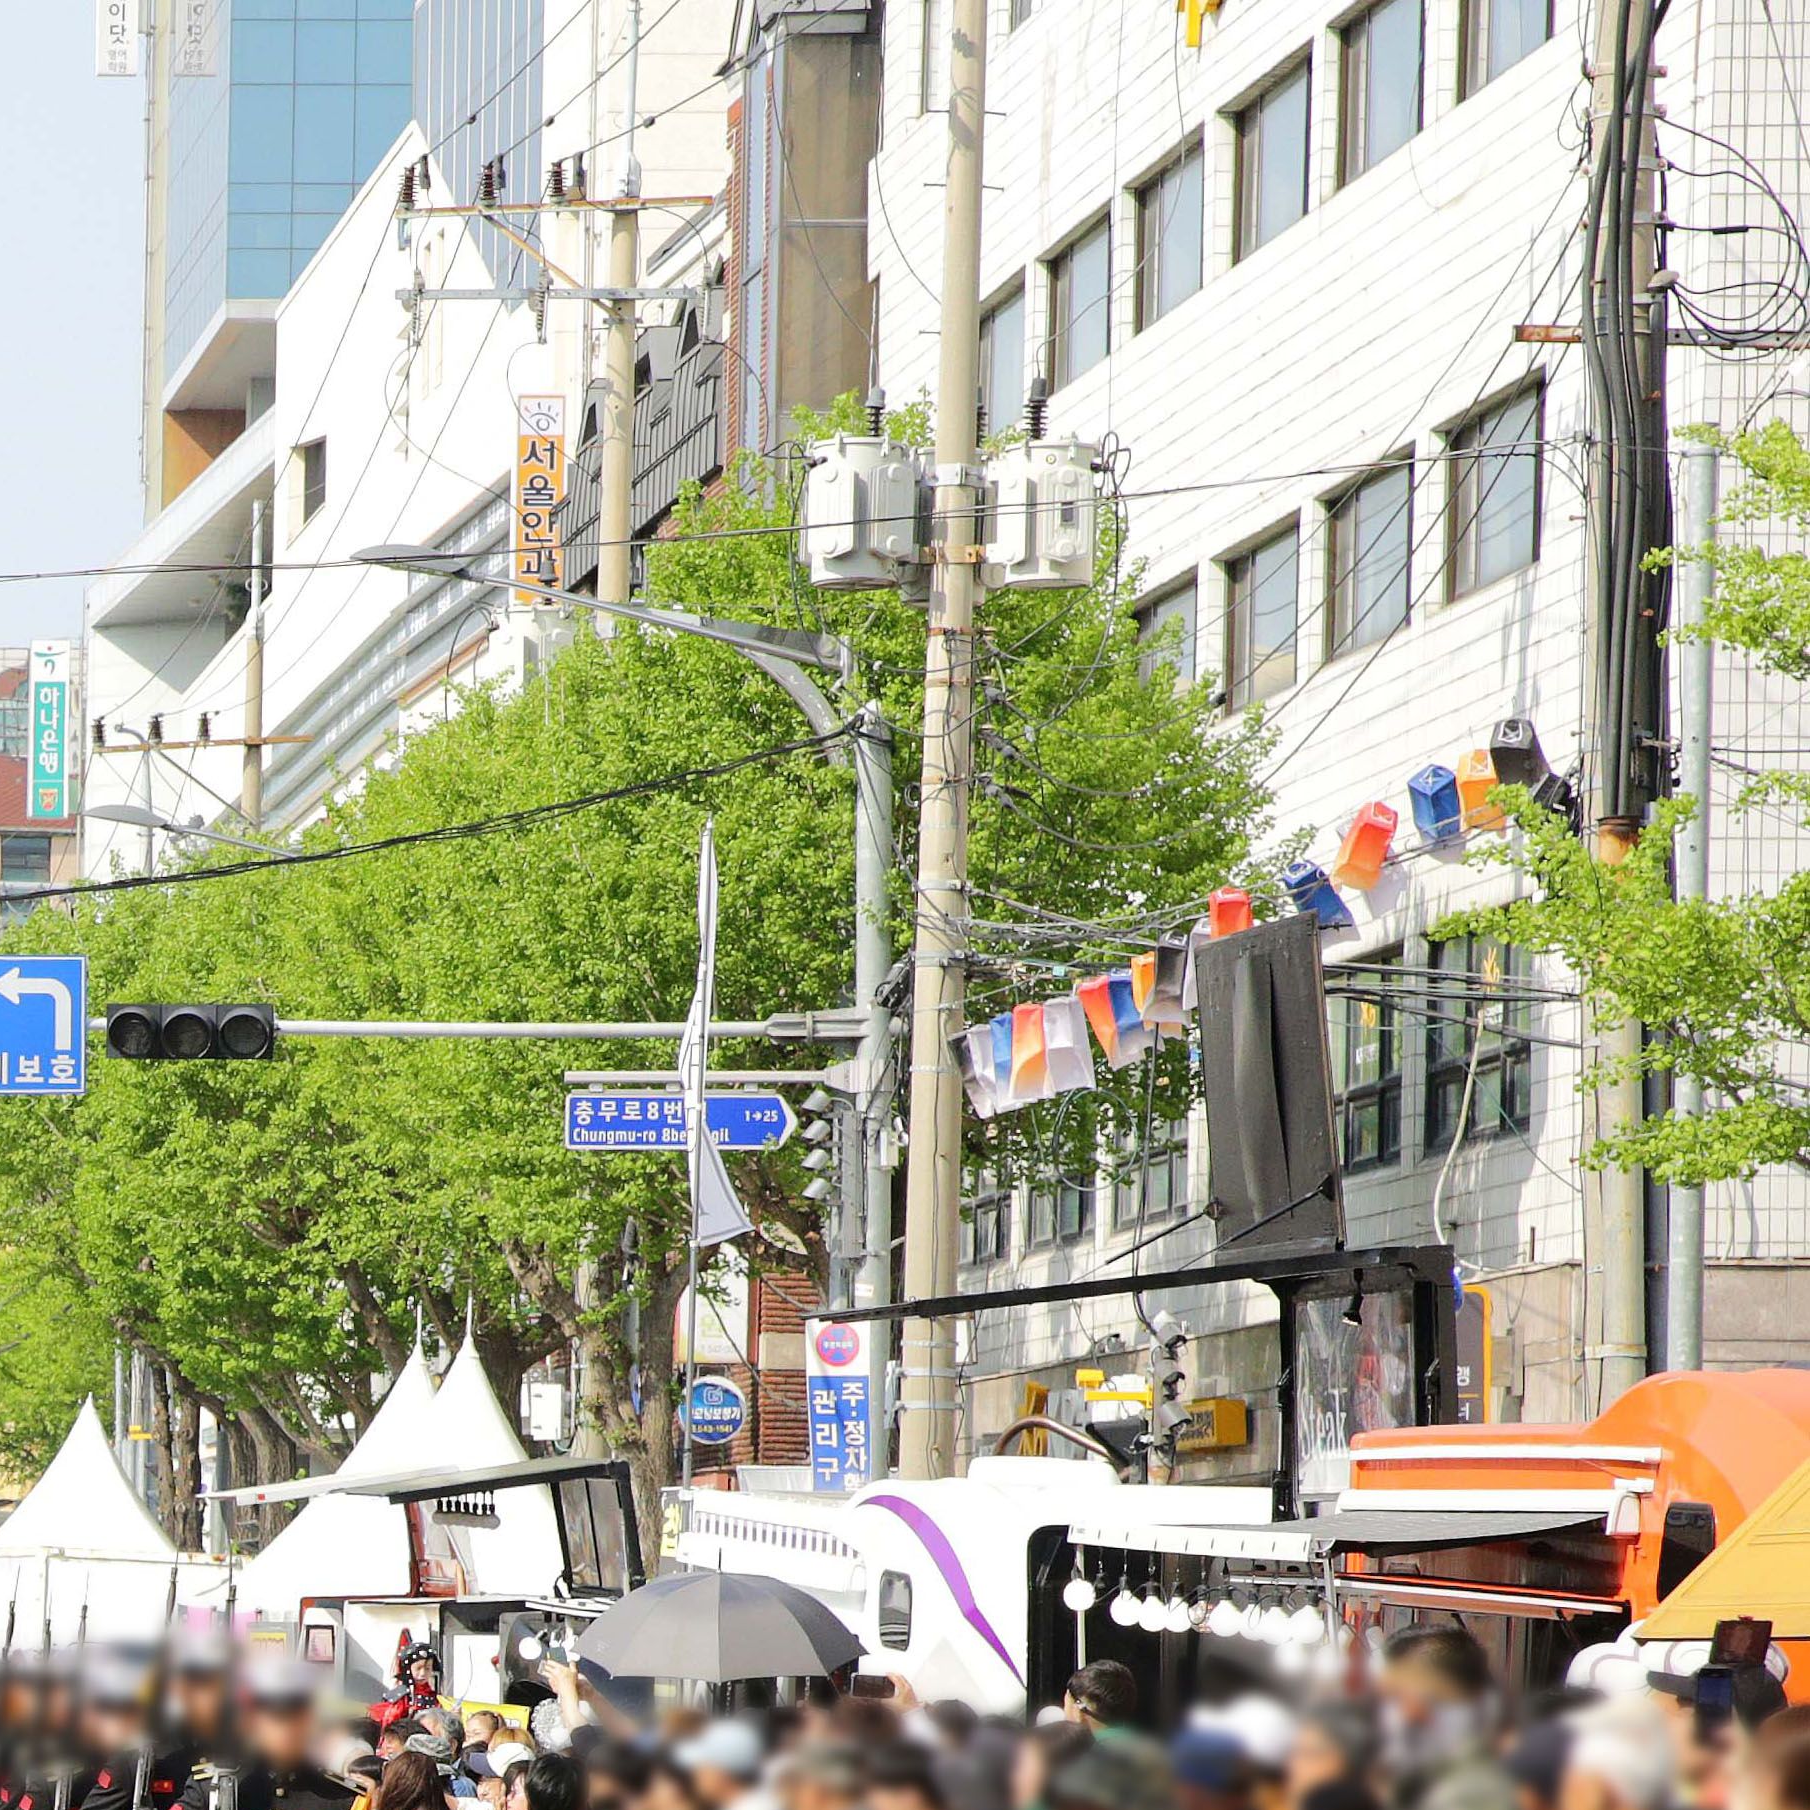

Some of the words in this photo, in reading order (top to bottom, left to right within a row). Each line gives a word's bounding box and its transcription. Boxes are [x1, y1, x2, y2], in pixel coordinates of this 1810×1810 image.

[521, 440, 557, 577] 서울안과
[39, 686, 60, 774] 하나은행
[572, 1128, 657, 1144] Chungmu-ro
[661, 1128, 731, 1144] 8begil
[573, 1100, 707, 1126] 충무로8번
